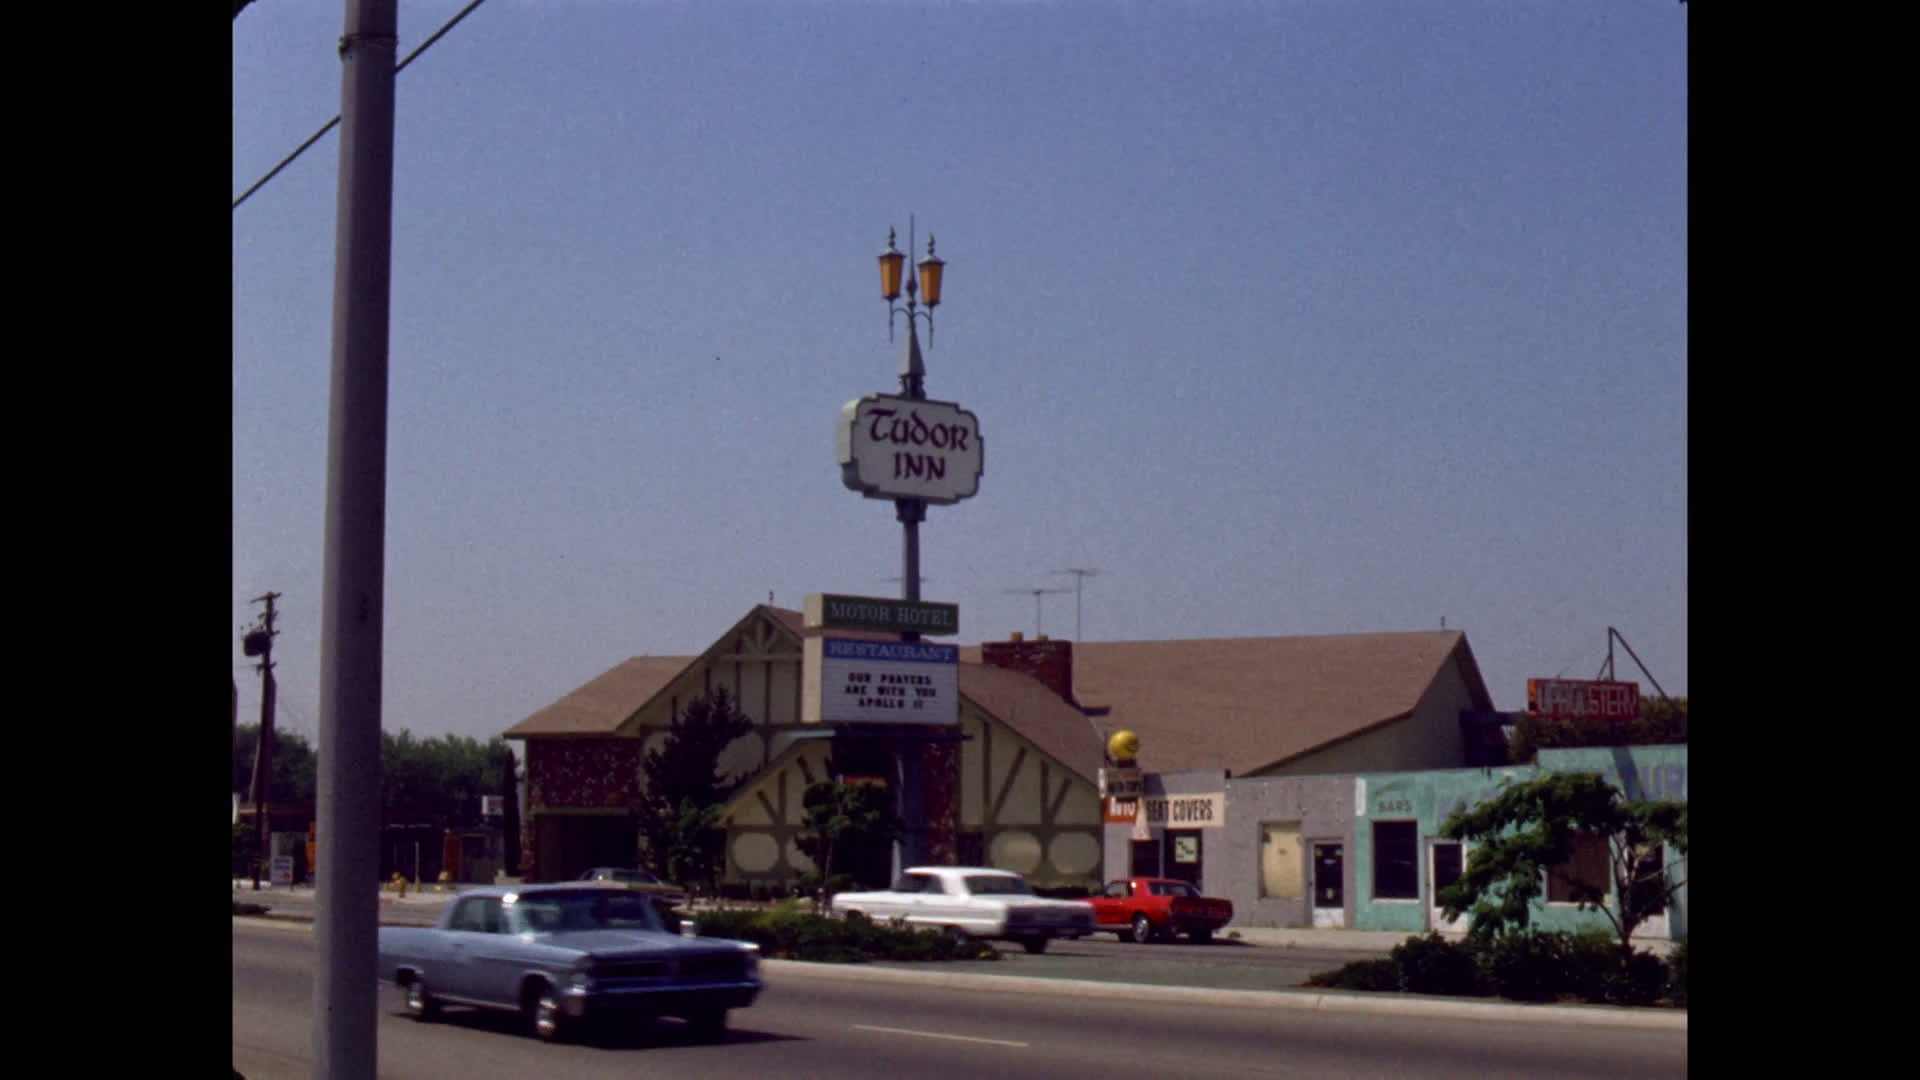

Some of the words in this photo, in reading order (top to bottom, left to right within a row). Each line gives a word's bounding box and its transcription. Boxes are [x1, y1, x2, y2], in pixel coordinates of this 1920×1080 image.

[894, 452, 945, 482] INN
[831, 602, 890, 621] MOTOR
[898, 607, 953, 625] HOTEL
[830, 642, 953, 661] RESTAURANT
[848, 673, 871, 683] OUR
[881, 674, 931, 685] PRAYERS
[845, 686, 867, 696] ARE
[877, 686, 905, 696] WITH
[915, 687, 936, 697] YOU
[859, 698, 905, 708] APOLLO
[1173, 799, 1213, 821] COVERS
